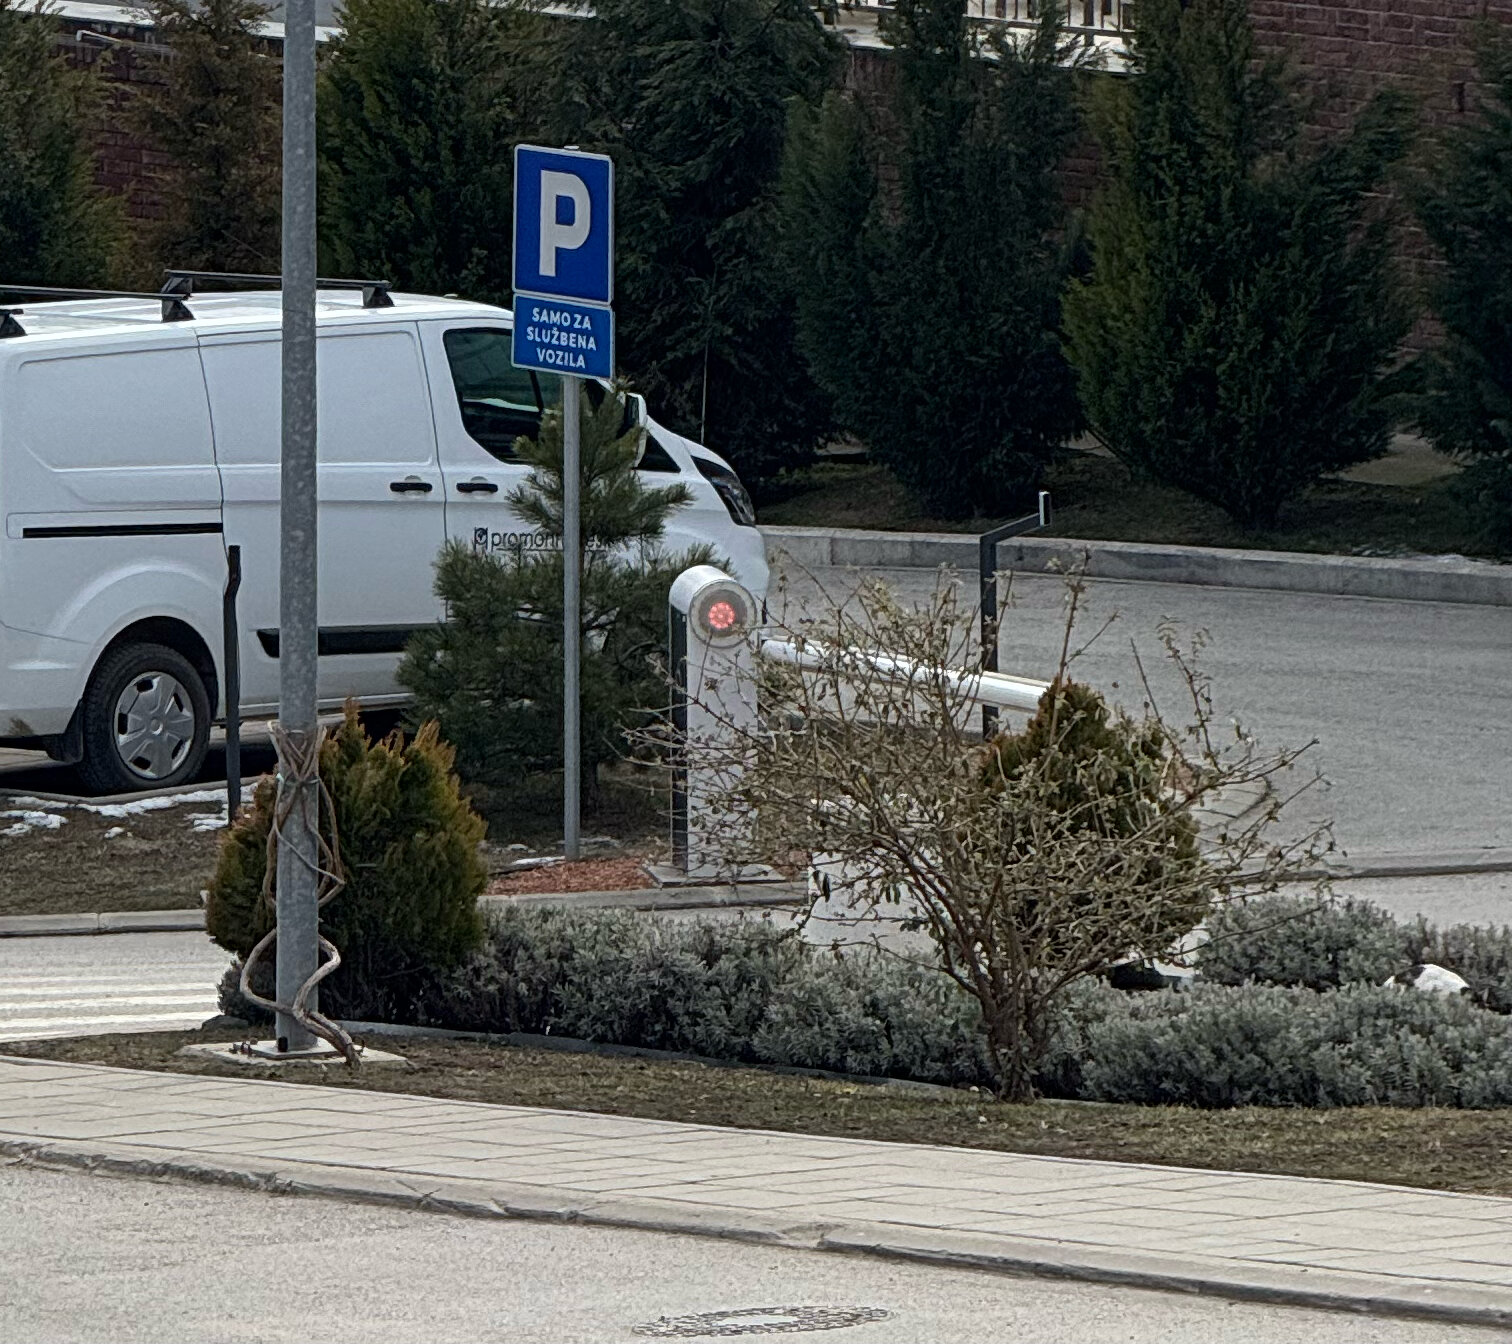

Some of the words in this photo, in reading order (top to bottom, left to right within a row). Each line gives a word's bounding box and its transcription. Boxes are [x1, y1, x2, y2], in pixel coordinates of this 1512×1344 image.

[539, 169, 591, 278] P
[532, 307, 570, 328] SAMO
[574, 314, 592, 331] ZA
[526, 326, 597, 351] SLUŽBENA
[537, 347, 586, 369] VOZILA
